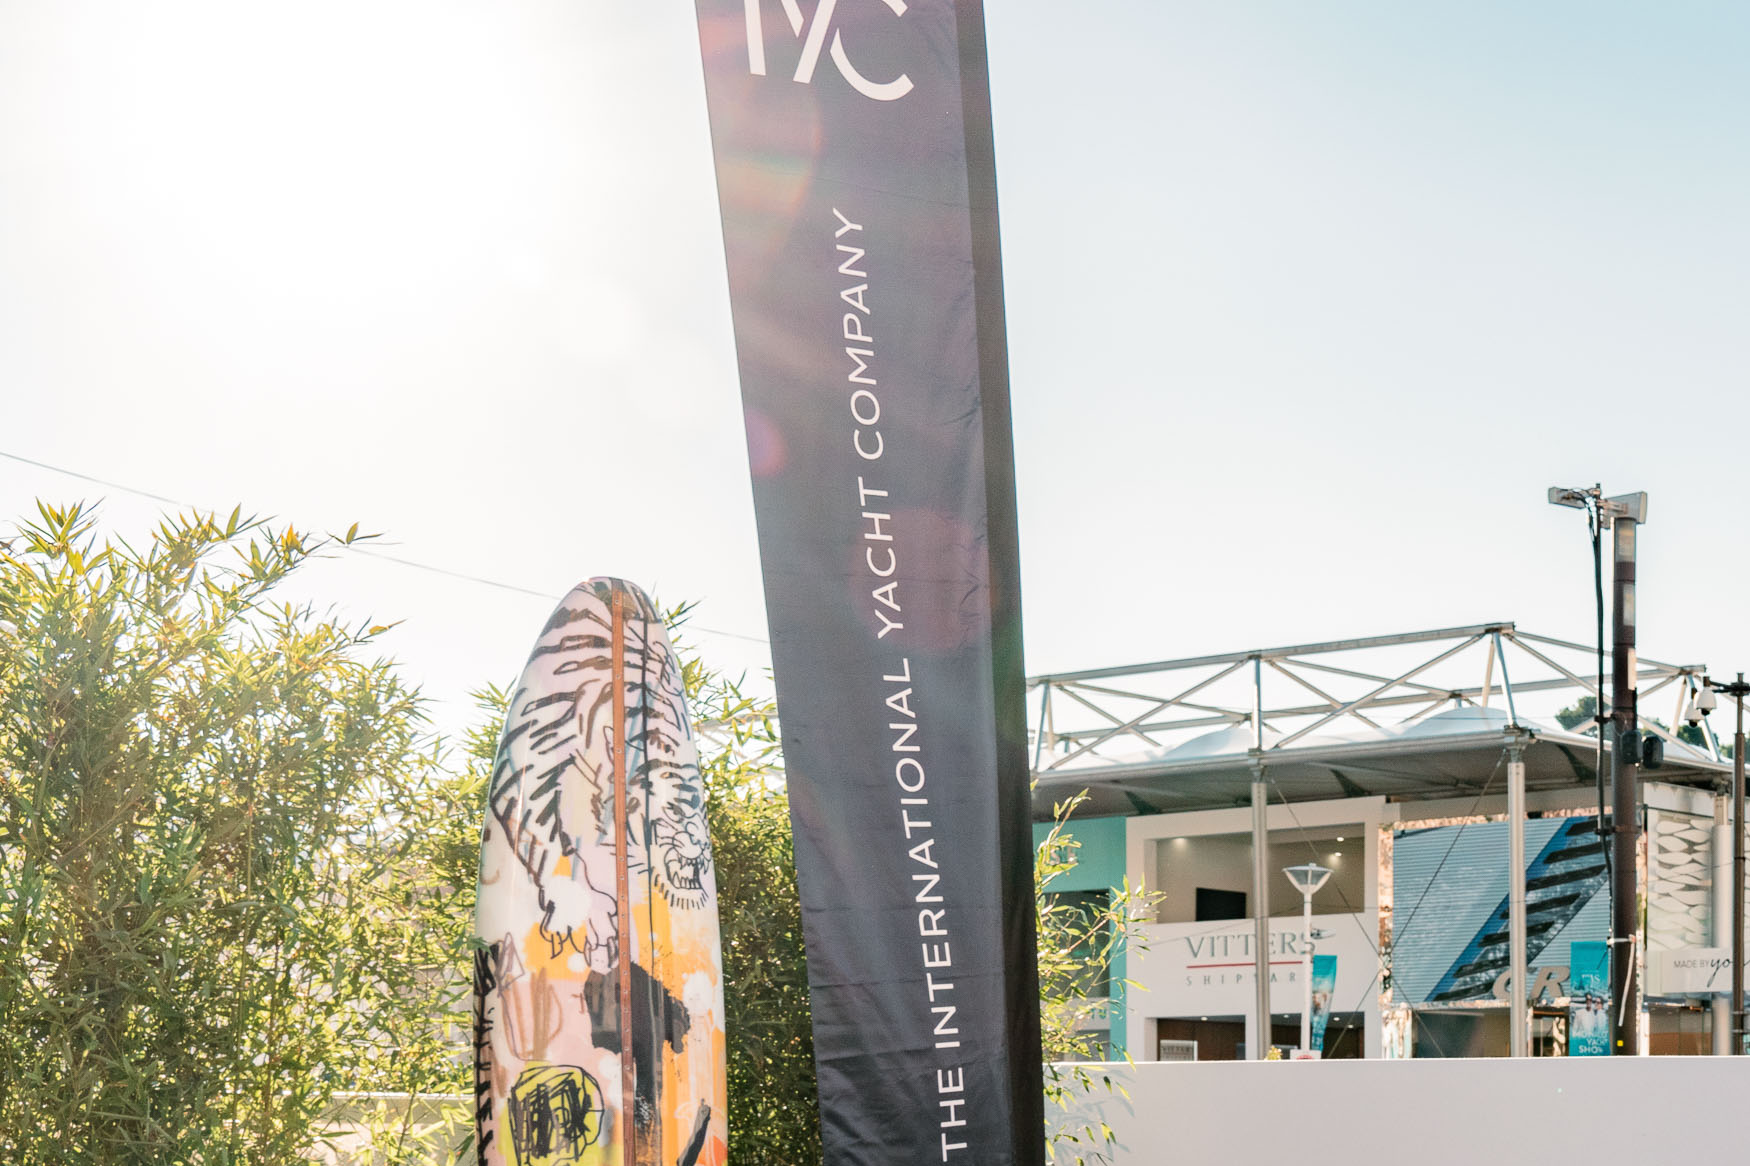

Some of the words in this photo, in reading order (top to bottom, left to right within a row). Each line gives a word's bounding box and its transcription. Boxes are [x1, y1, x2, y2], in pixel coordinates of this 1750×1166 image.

[832, 207, 884, 461] COMPANY
[857, 475, 904, 639] YACHT
[883, 657, 961, 1049] INTERNATIONAL
[937, 1066, 968, 1163] THE
